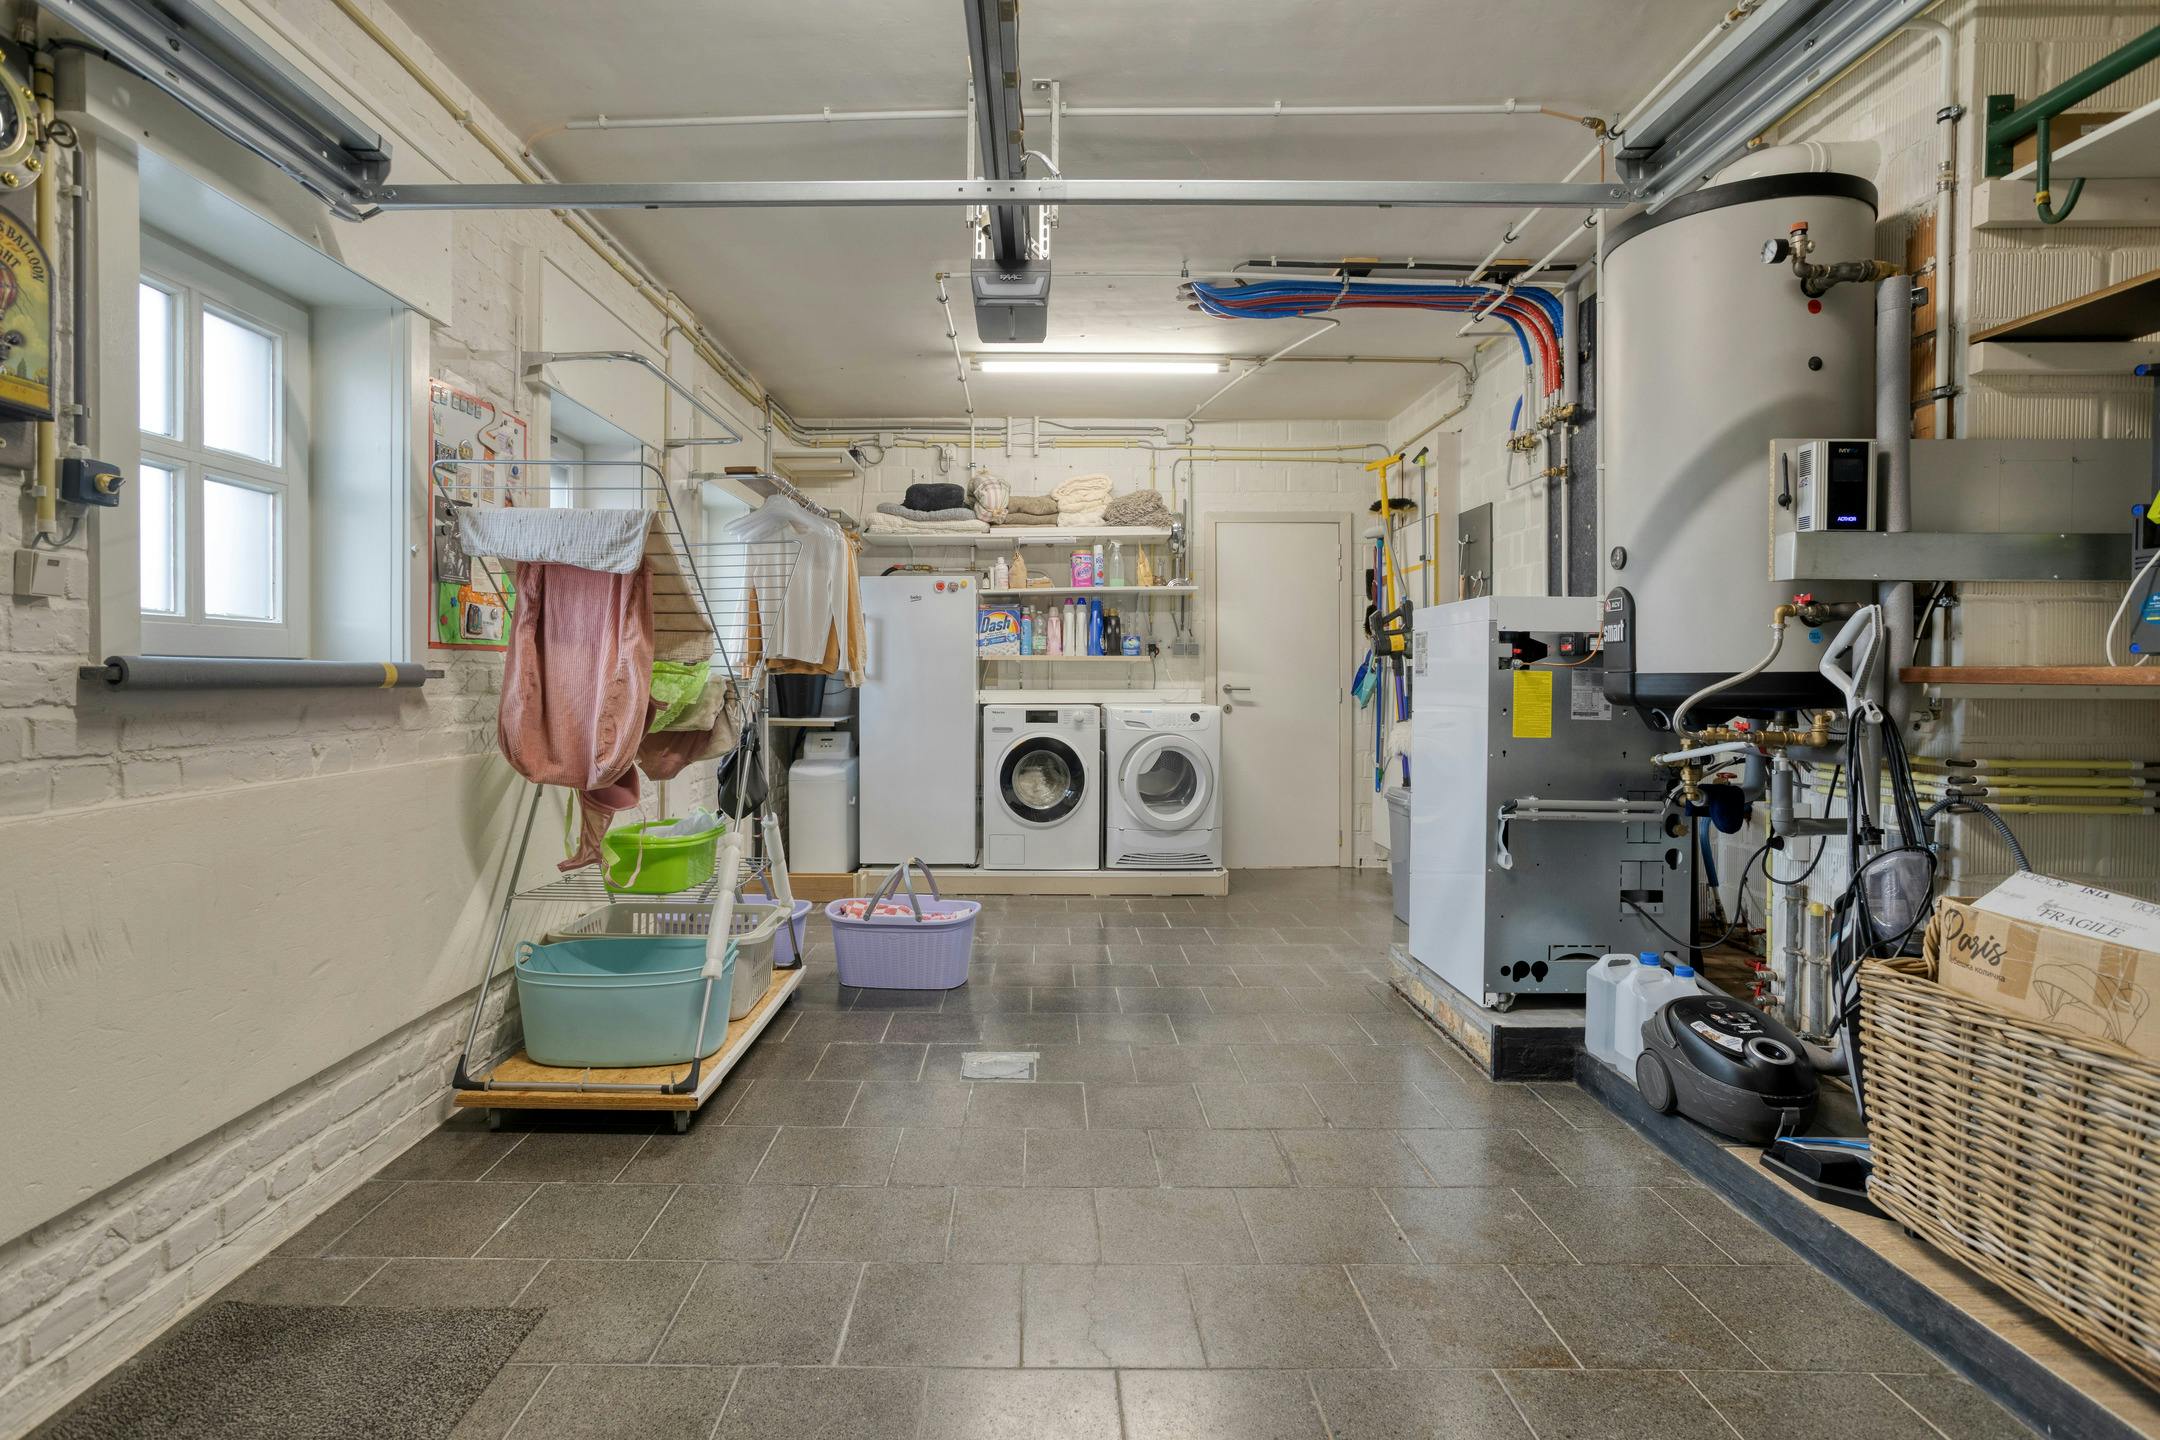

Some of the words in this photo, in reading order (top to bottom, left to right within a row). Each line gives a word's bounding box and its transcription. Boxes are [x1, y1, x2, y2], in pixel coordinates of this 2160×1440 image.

[6, 225, 45, 283] BALLOON
[999, 273, 1022, 281] FAAC
[981, 615, 1011, 633] Dash
[1603, 619, 1625, 642] smart
[2038, 908, 2125, 938] FRAGILE
[1944, 907, 2008, 967] Paris
